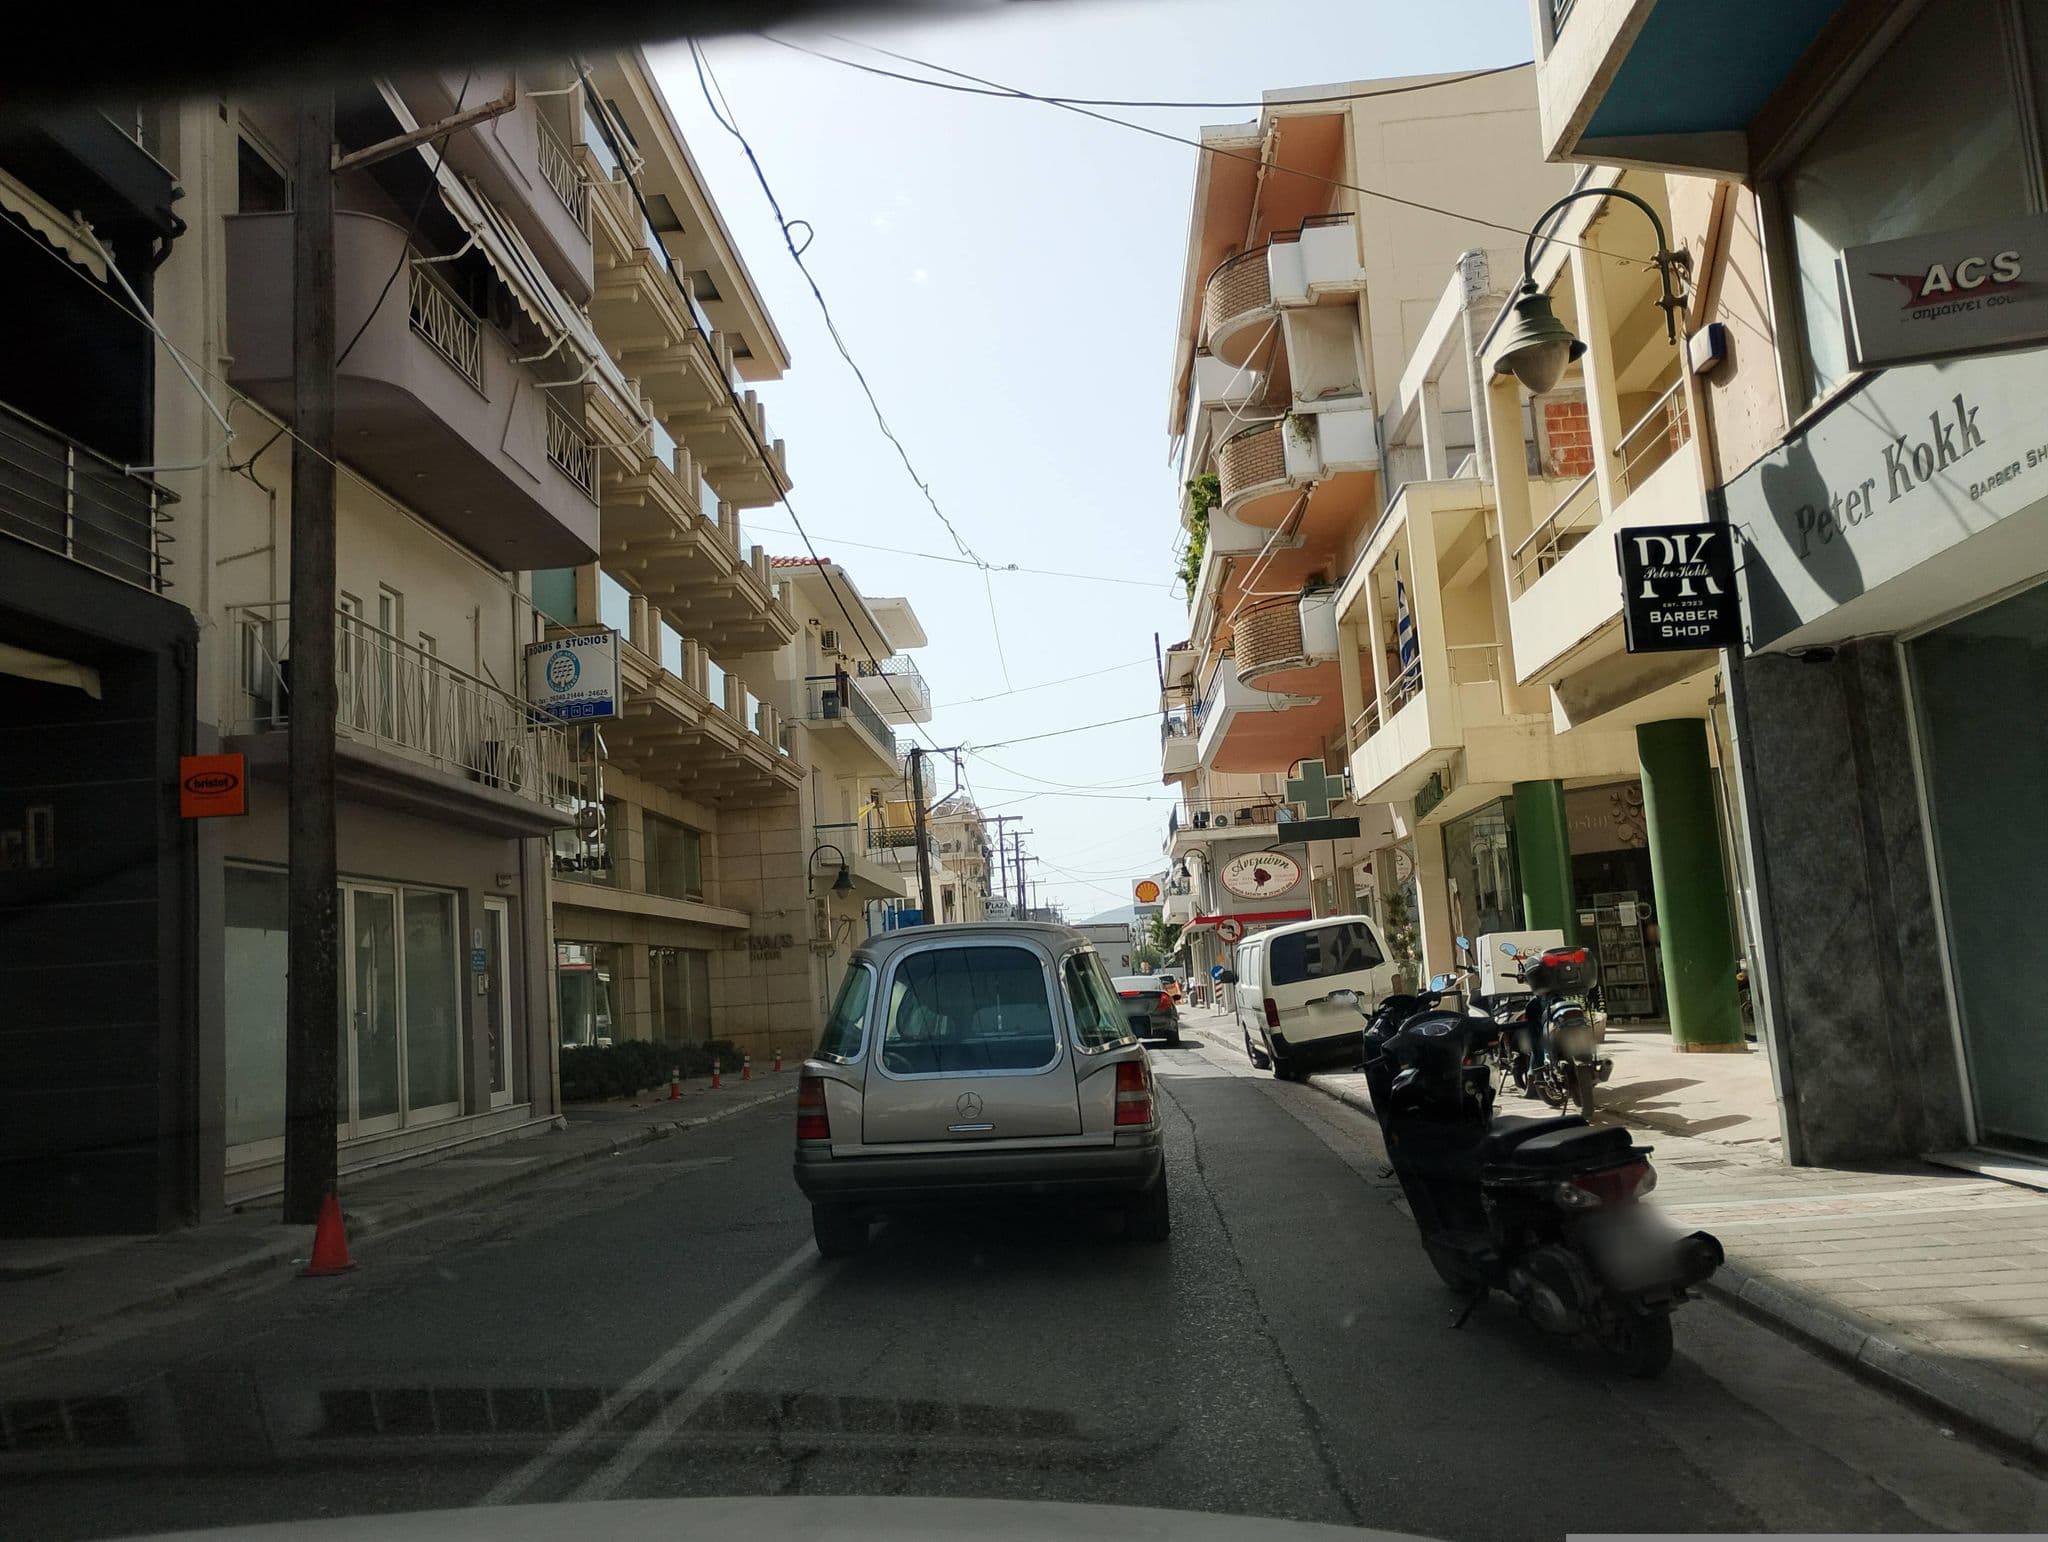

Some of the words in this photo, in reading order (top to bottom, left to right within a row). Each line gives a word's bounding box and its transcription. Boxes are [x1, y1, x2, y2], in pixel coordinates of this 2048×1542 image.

[1921, 250, 2023, 297] ACS
[1793, 477, 1876, 560] Peter
[1881, 393, 1986, 504] Kokk
[1969, 460, 2022, 502] BARBER
[2026, 443, 2048, 468] SH
[1632, 532, 1724, 598] PK
[1643, 566, 1677, 580] Peter
[1649, 609, 1719, 624] BARBER
[1662, 624, 1710, 637] SHOP
[528, 643, 553, 656] ROOMS
[555, 641, 562, 650] &
[565, 634, 609, 649] STUDIOS
[985, 902, 1009, 910] PLAZA
